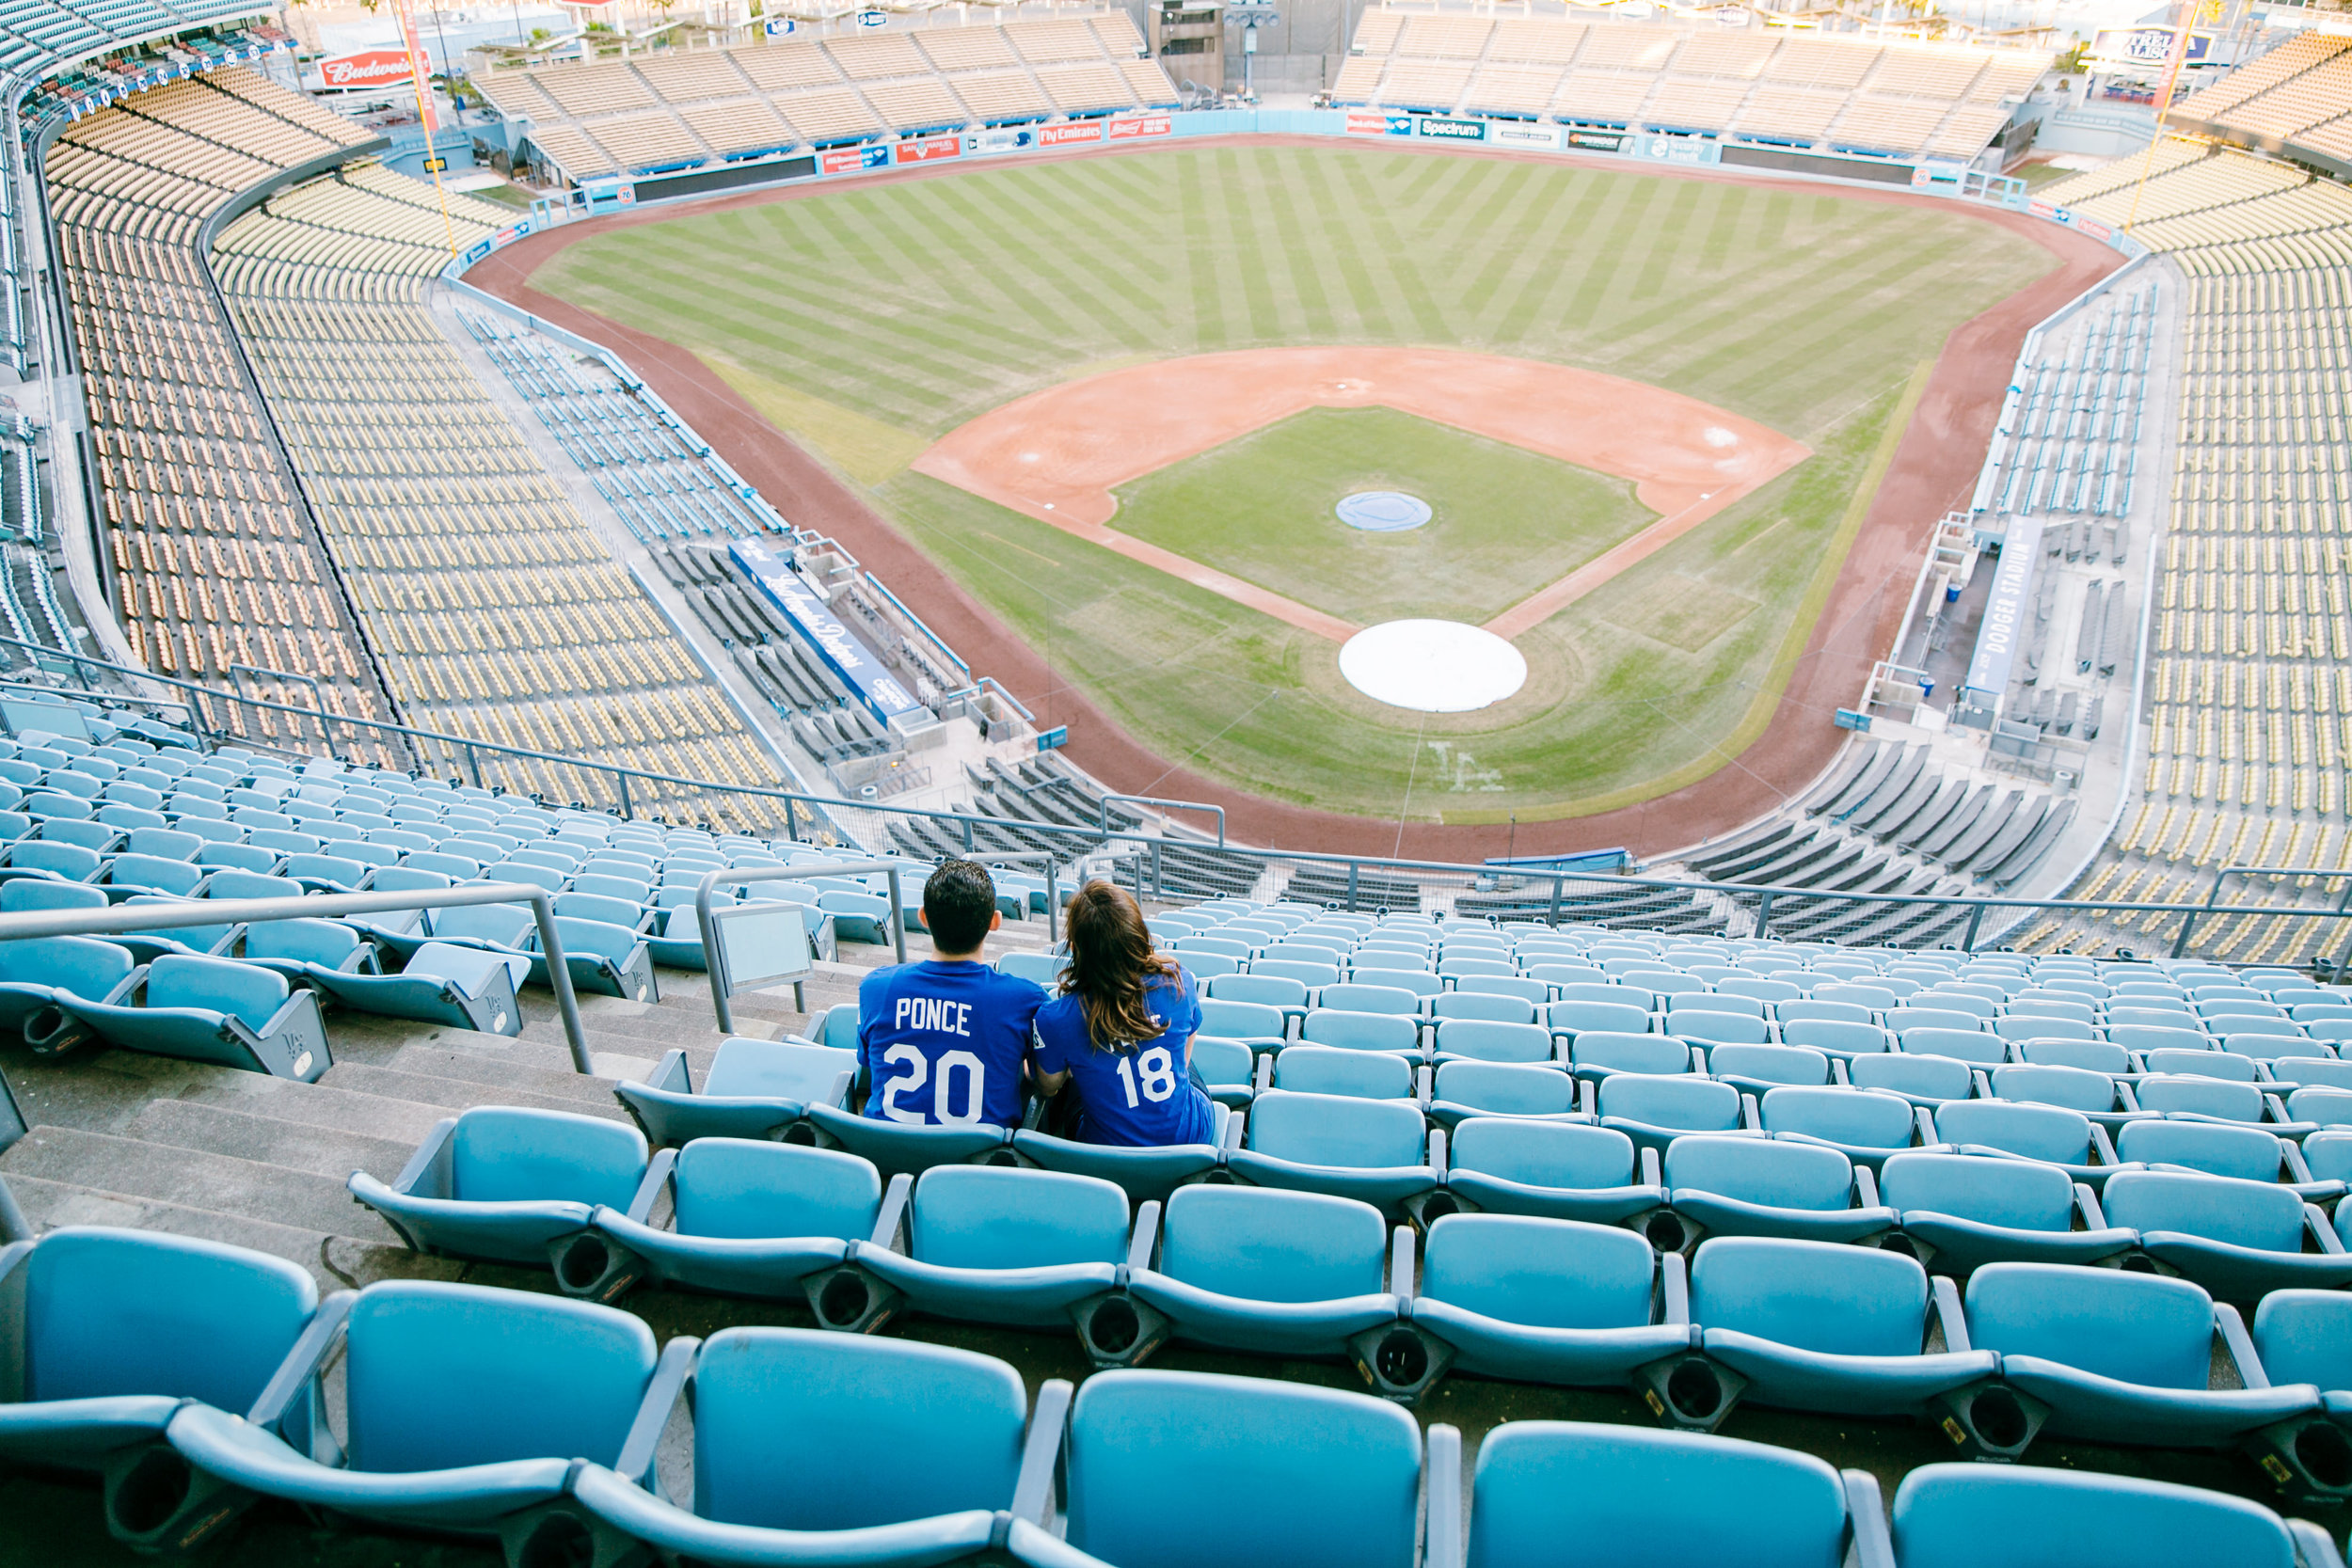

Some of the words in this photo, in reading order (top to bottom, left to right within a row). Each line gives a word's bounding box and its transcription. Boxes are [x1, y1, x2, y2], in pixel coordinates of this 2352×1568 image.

[902, 144, 917, 152] SAN
[927, 140, 954, 149] MANUEL
[1040, 128, 1057, 143] Fly
[1057, 124, 1101, 140] Emirates
[1422, 121, 1479, 136] Spectrum
[622, 191, 632, 199] 76
[2000, 542, 2031, 595] STADIUM
[816, 624, 864, 669] Dodgers
[1985, 598, 2018, 654] DODGER
[896, 997, 973, 1037] PONCE
[882, 1043, 985, 1125] 20
[1117, 1046, 1177, 1108] 18
